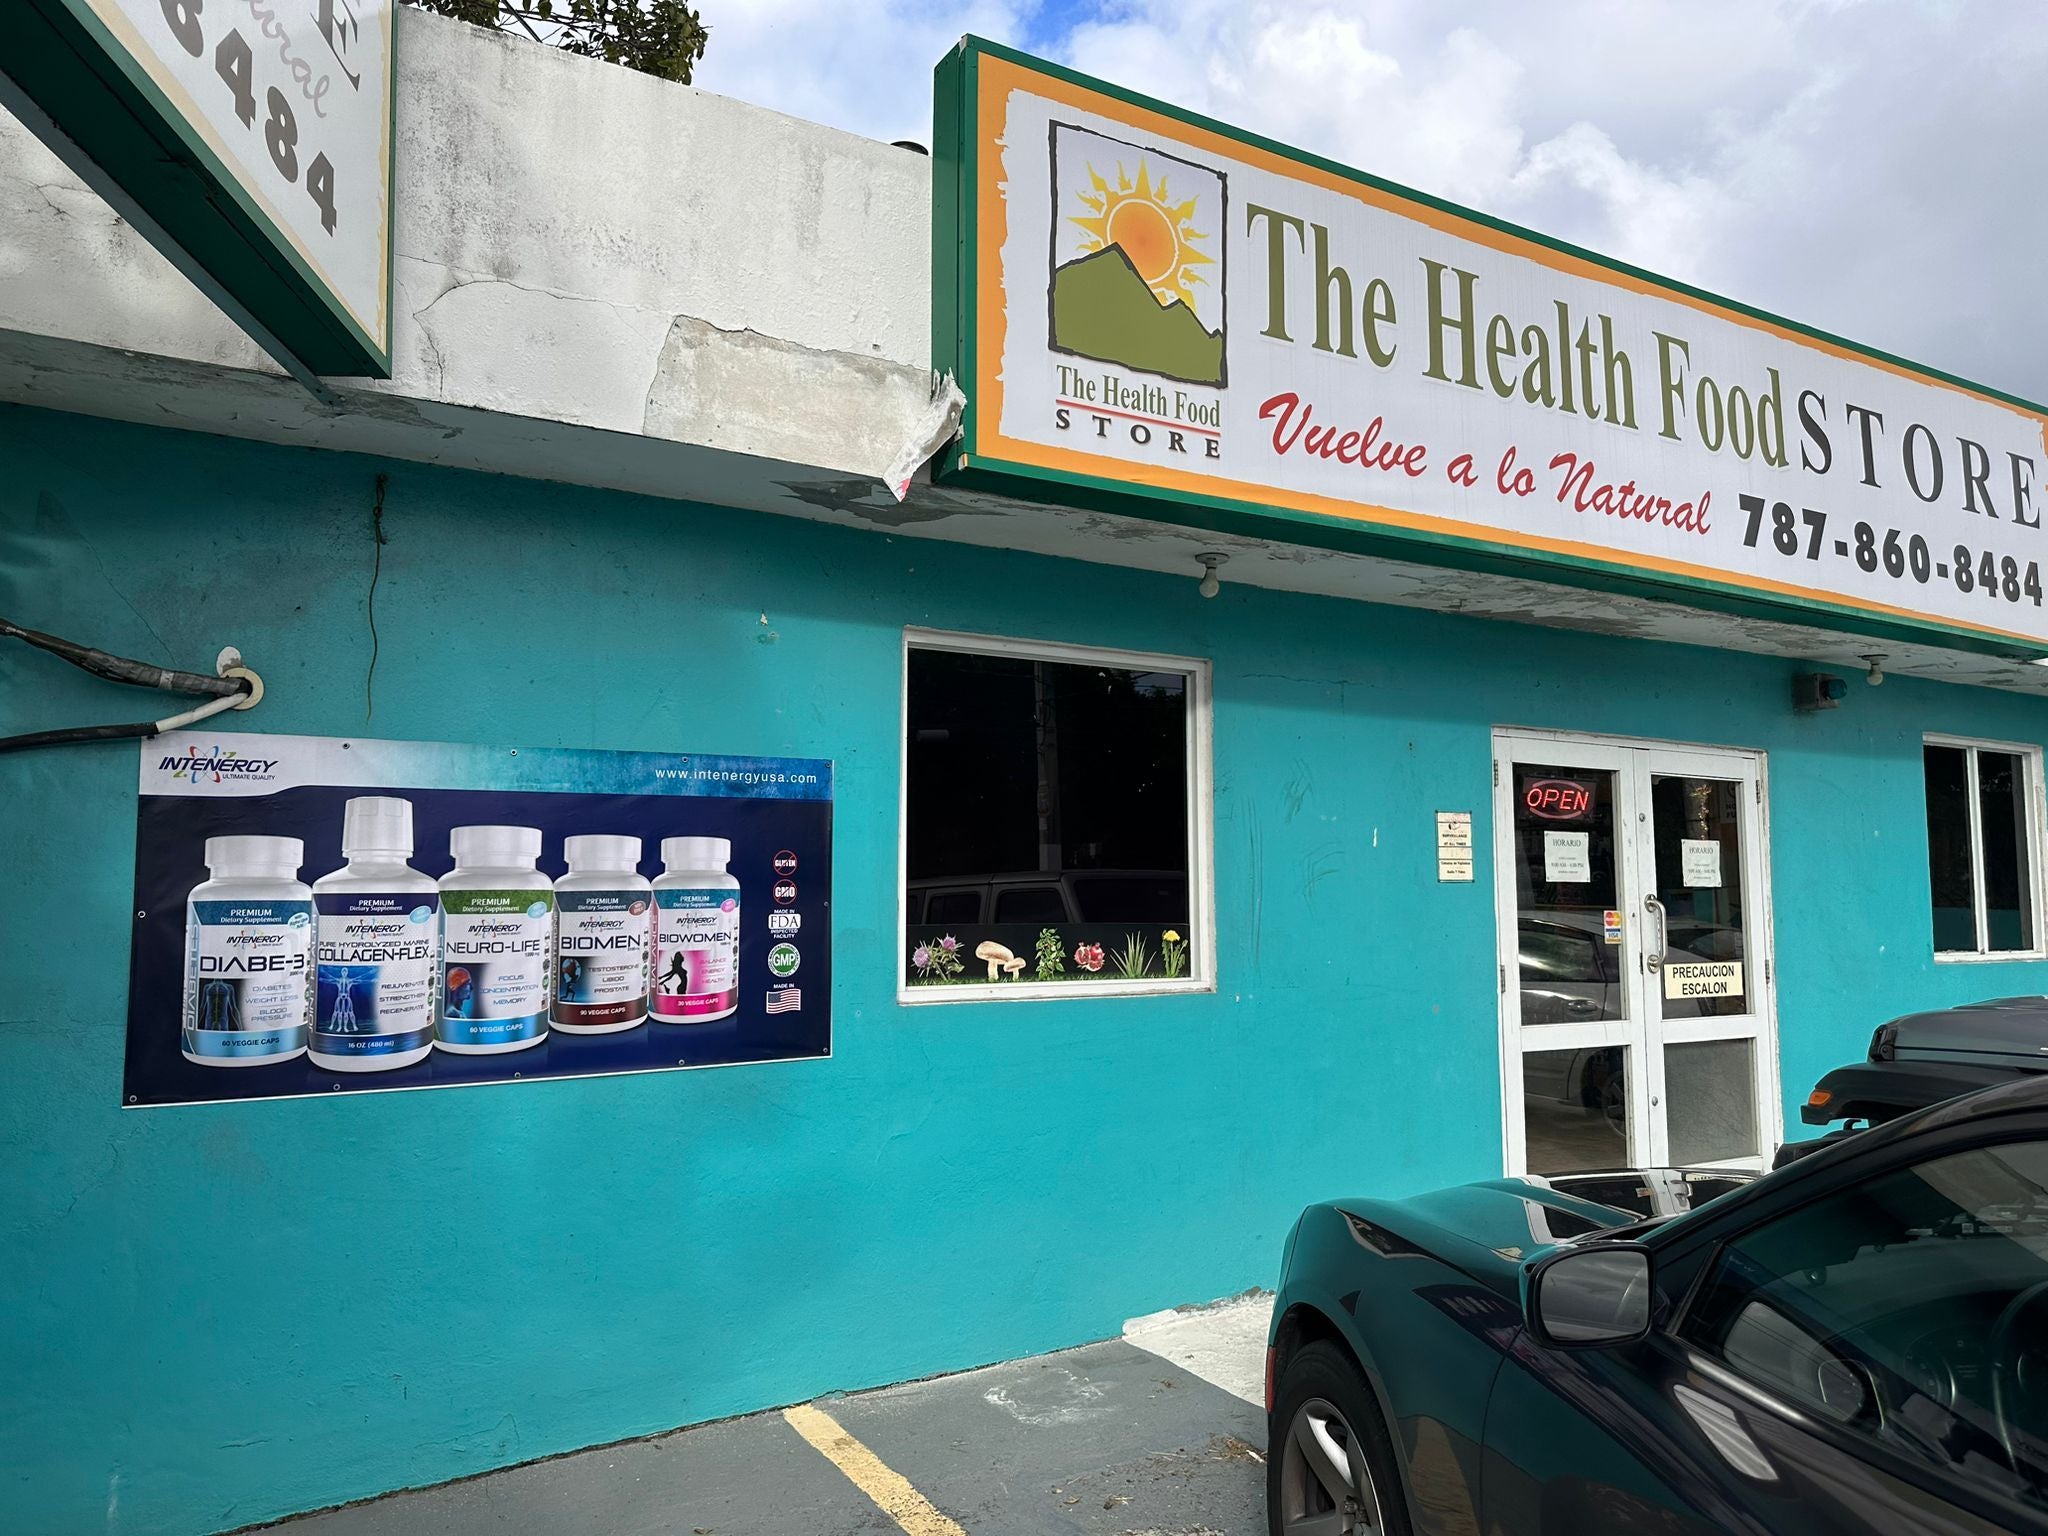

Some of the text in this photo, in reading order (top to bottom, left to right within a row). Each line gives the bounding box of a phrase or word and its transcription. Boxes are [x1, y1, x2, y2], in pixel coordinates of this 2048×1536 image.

[1247, 203, 2041, 529] The Health Food STORE
[1056, 364, 1221, 428] The Health Food
[1056, 408, 1220, 459] STORE
[1259, 392, 2043, 608] Vuelve a lo Natural 787-860-8484
[158, 756, 279, 774] INTENERGY
[655, 768, 818, 785] www.intenergyusa.com
[1526, 788, 1590, 811] OPEN
[1552, 838, 1582, 848] HORARIO
[1689, 847, 1714, 855] HORARIO
[774, 886, 796, 897] GMO
[471, 898, 510, 906] PREMIUM
[230, 908, 272, 917] PREMIUM
[462, 905, 483, 913] Dietary
[220, 917, 243, 925] Dietary
[244, 916, 282, 925] Supplement
[578, 920, 625, 928] INTENERGY
[676, 916, 718, 924] INTENERGY
[770, 915, 799, 928] FDA
[345, 924, 406, 933] INTENERGY
[468, 924, 523, 933] INTENERGY
[226, 935, 285, 944] INTENERGY
[561, 934, 641, 950] BIOMEN
[659, 931, 732, 943] BIOWOMEN
[338, 940, 401, 948] HYDROLYZED
[446, 939, 541, 954] NEURO-LIFE
[318, 945, 430, 962] COLLAGEN-FLEX
[200, 953, 305, 973] DIABE-3
[773, 953, 796, 967] GMP
[435, 934, 444, 999] FOCUS
[587, 963, 640, 972] TESTOSTERONE
[1672, 964, 1735, 979] PRECAUCION
[187, 924, 199, 1031] DIABETES
[252, 983, 293, 992] DIABETES
[381, 980, 425, 990] REJUVENATE
[593, 985, 630, 993] PROSTATE
[1682, 981, 1728, 996] ESCALON
[245, 996, 278, 1005] WEIGHT
[379, 992, 426, 1003] STRENGTHEN
[493, 996, 528, 1005] MEMORY
[259, 1007, 288, 1015] BLOOD
[380, 1004, 424, 1015] REGENERATE
[588, 1008, 610, 1016] VEGGIE
[610, 1006, 626, 1014] CAPS
[251, 1012, 293, 1022] PRESSURE
[479, 1025, 505, 1033] VEGGIE
[505, 1023, 524, 1031] CAPS
[232, 1039, 260, 1047] VEGGIE
[260, 1037, 280, 1045] CAPS
[356, 1041, 367, 1049] OZ
